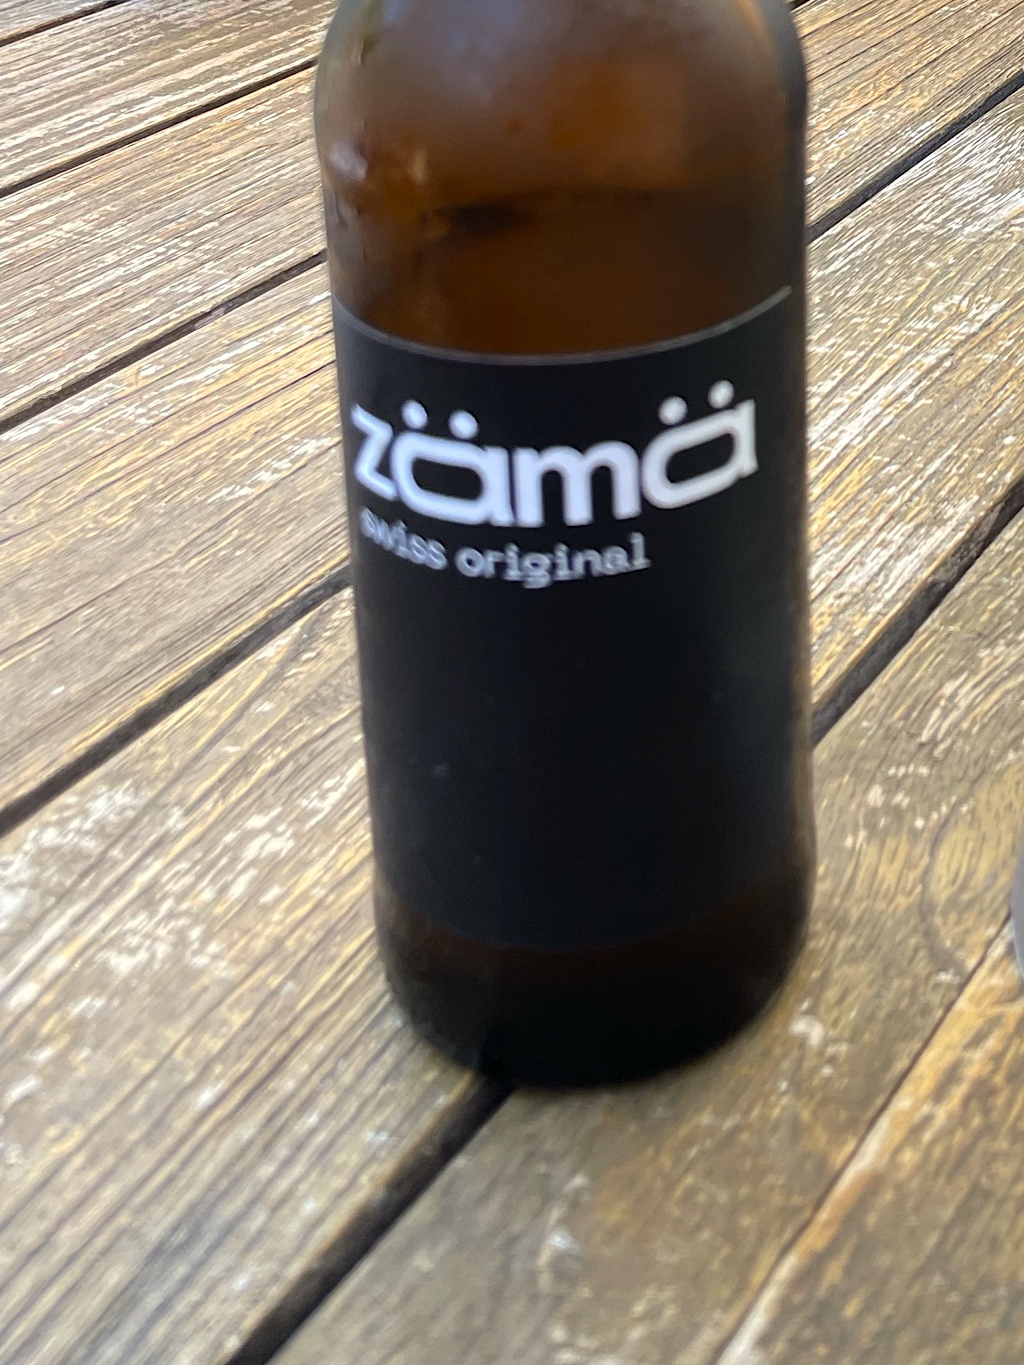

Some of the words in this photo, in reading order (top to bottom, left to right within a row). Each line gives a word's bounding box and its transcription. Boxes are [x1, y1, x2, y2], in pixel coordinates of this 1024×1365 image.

[350, 379, 759, 528] zämä
[360, 506, 448, 570] swiss
[454, 531, 651, 589] original
